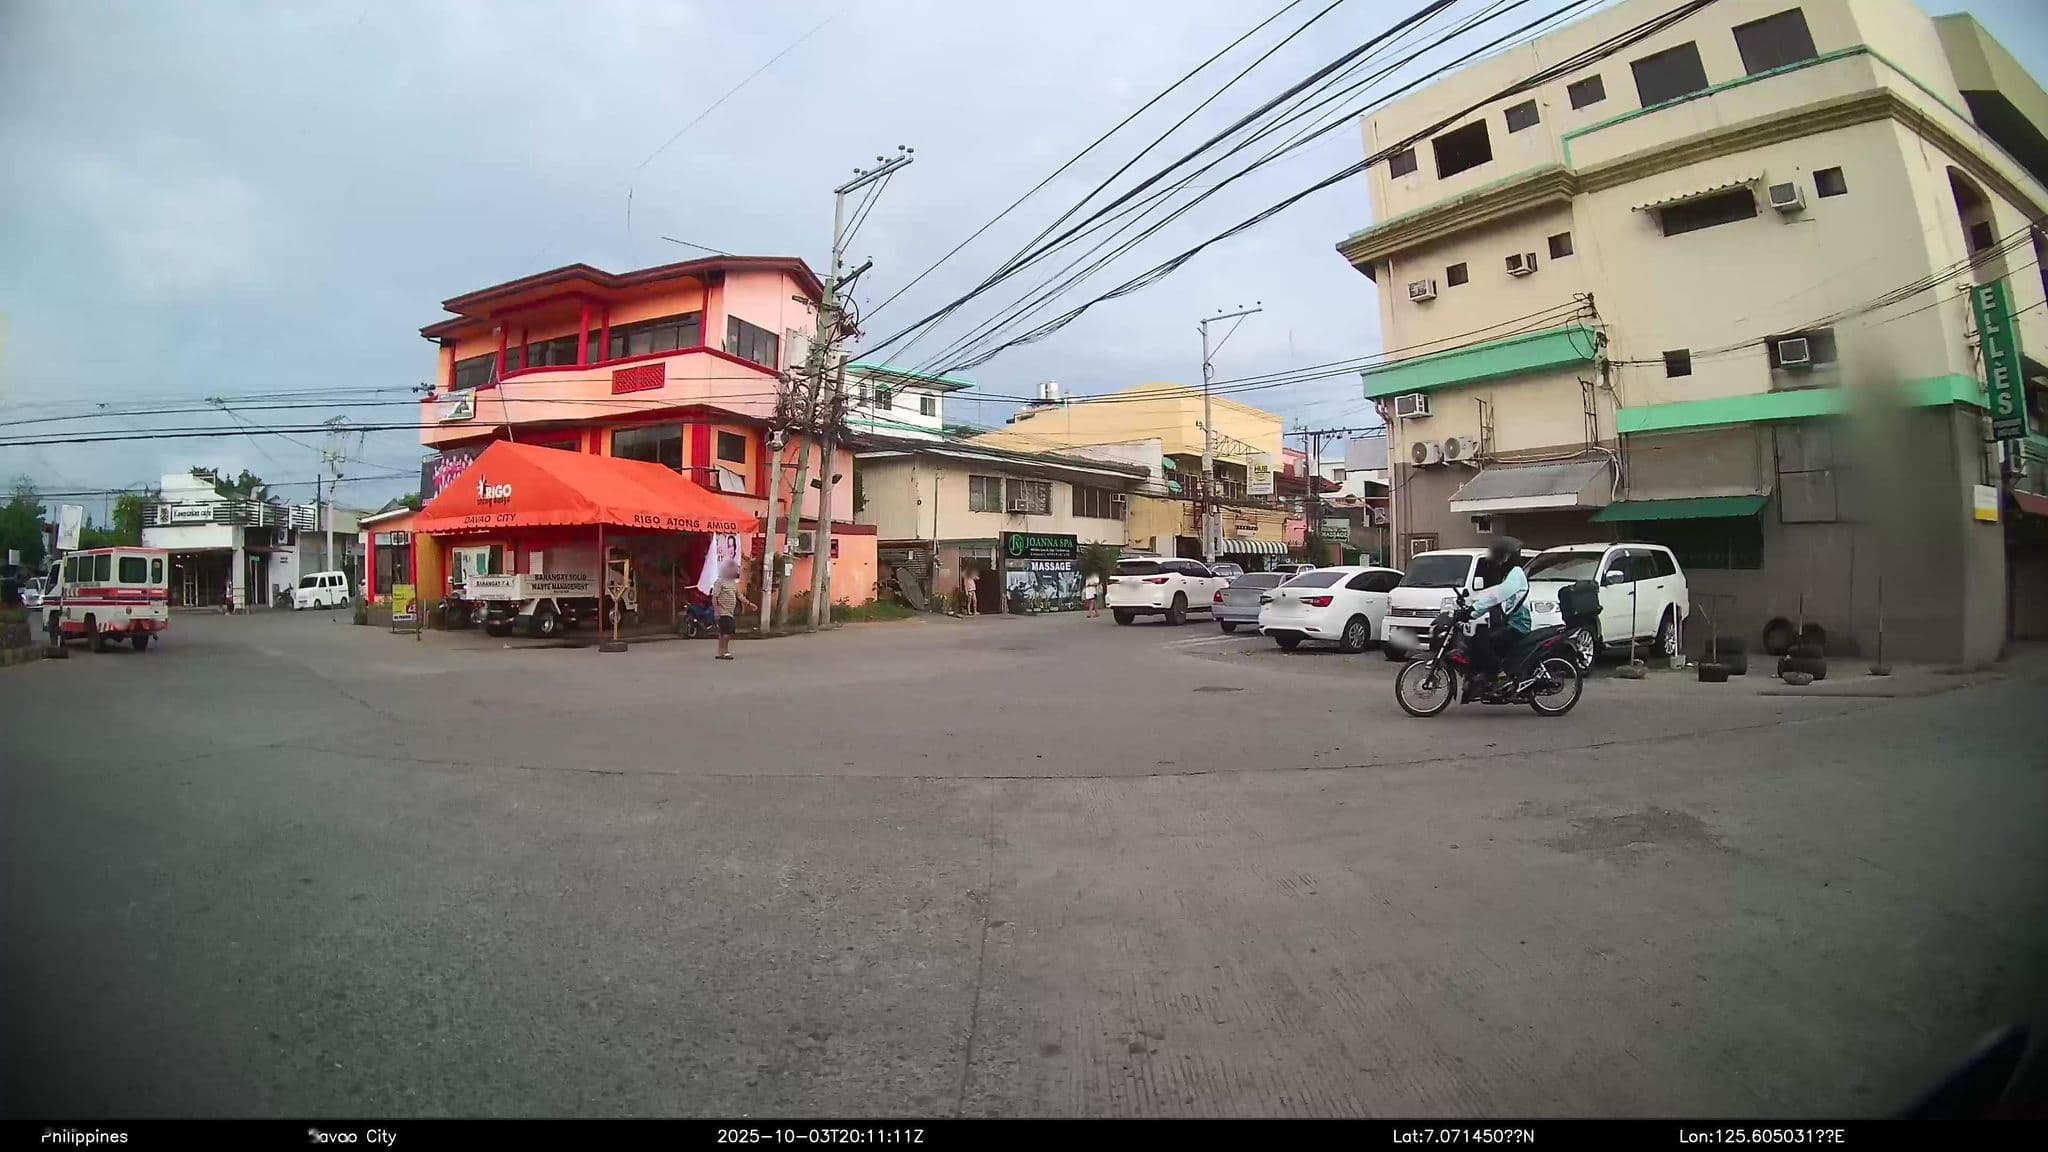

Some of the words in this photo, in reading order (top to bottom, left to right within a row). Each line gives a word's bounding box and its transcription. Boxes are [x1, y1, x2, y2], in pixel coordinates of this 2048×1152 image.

[464, 515, 491, 523] DAVAO
[497, 513, 516, 522] CITY
[634, 514, 660, 524] RIGO
[667, 517, 700, 528] ATONG
[707, 521, 737, 530] AMIGO
[1025, 537, 1059, 548] JOANNA
[1060, 538, 1073, 547] SPA
[1031, 562, 1071, 571] MASSAGE
[531, 583, 551, 591] WASTE
